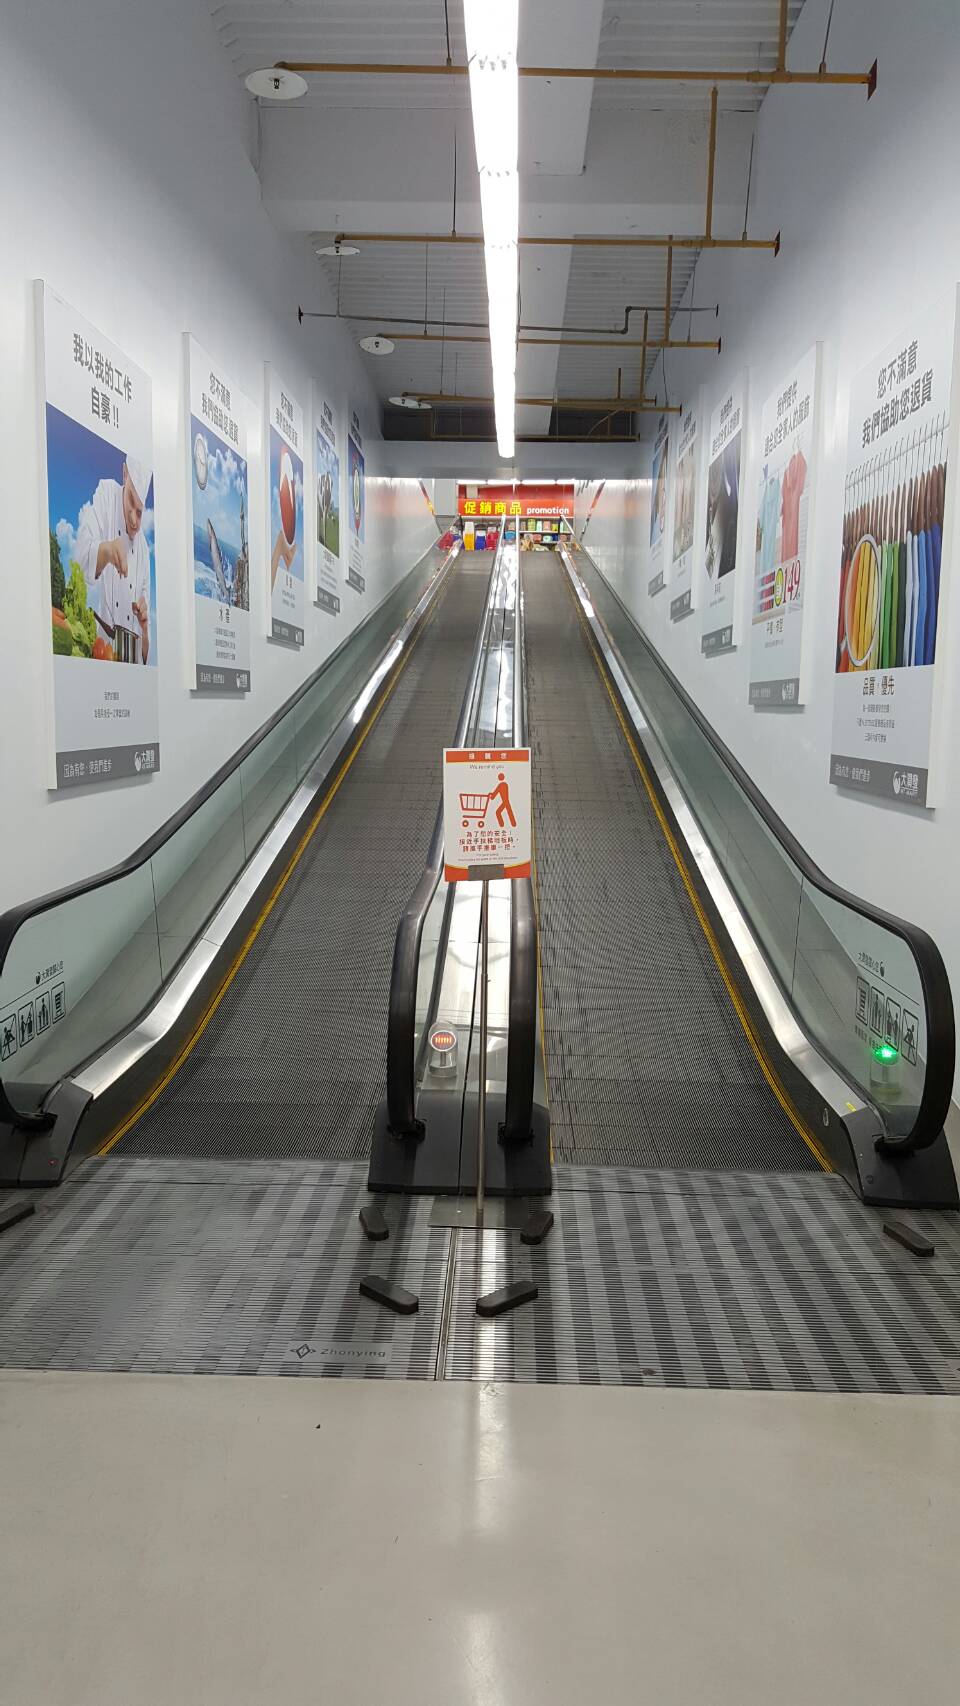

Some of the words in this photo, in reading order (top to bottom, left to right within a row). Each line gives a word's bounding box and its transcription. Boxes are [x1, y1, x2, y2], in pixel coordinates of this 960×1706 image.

[73, 333, 132, 404] 我以我的工作
[877, 340, 918, 399] 您不滿意
[862, 368, 933, 448] 我們協助您退貨
[464, 501, 522, 515] 促銷商品
[526, 506, 569, 515] promotion
